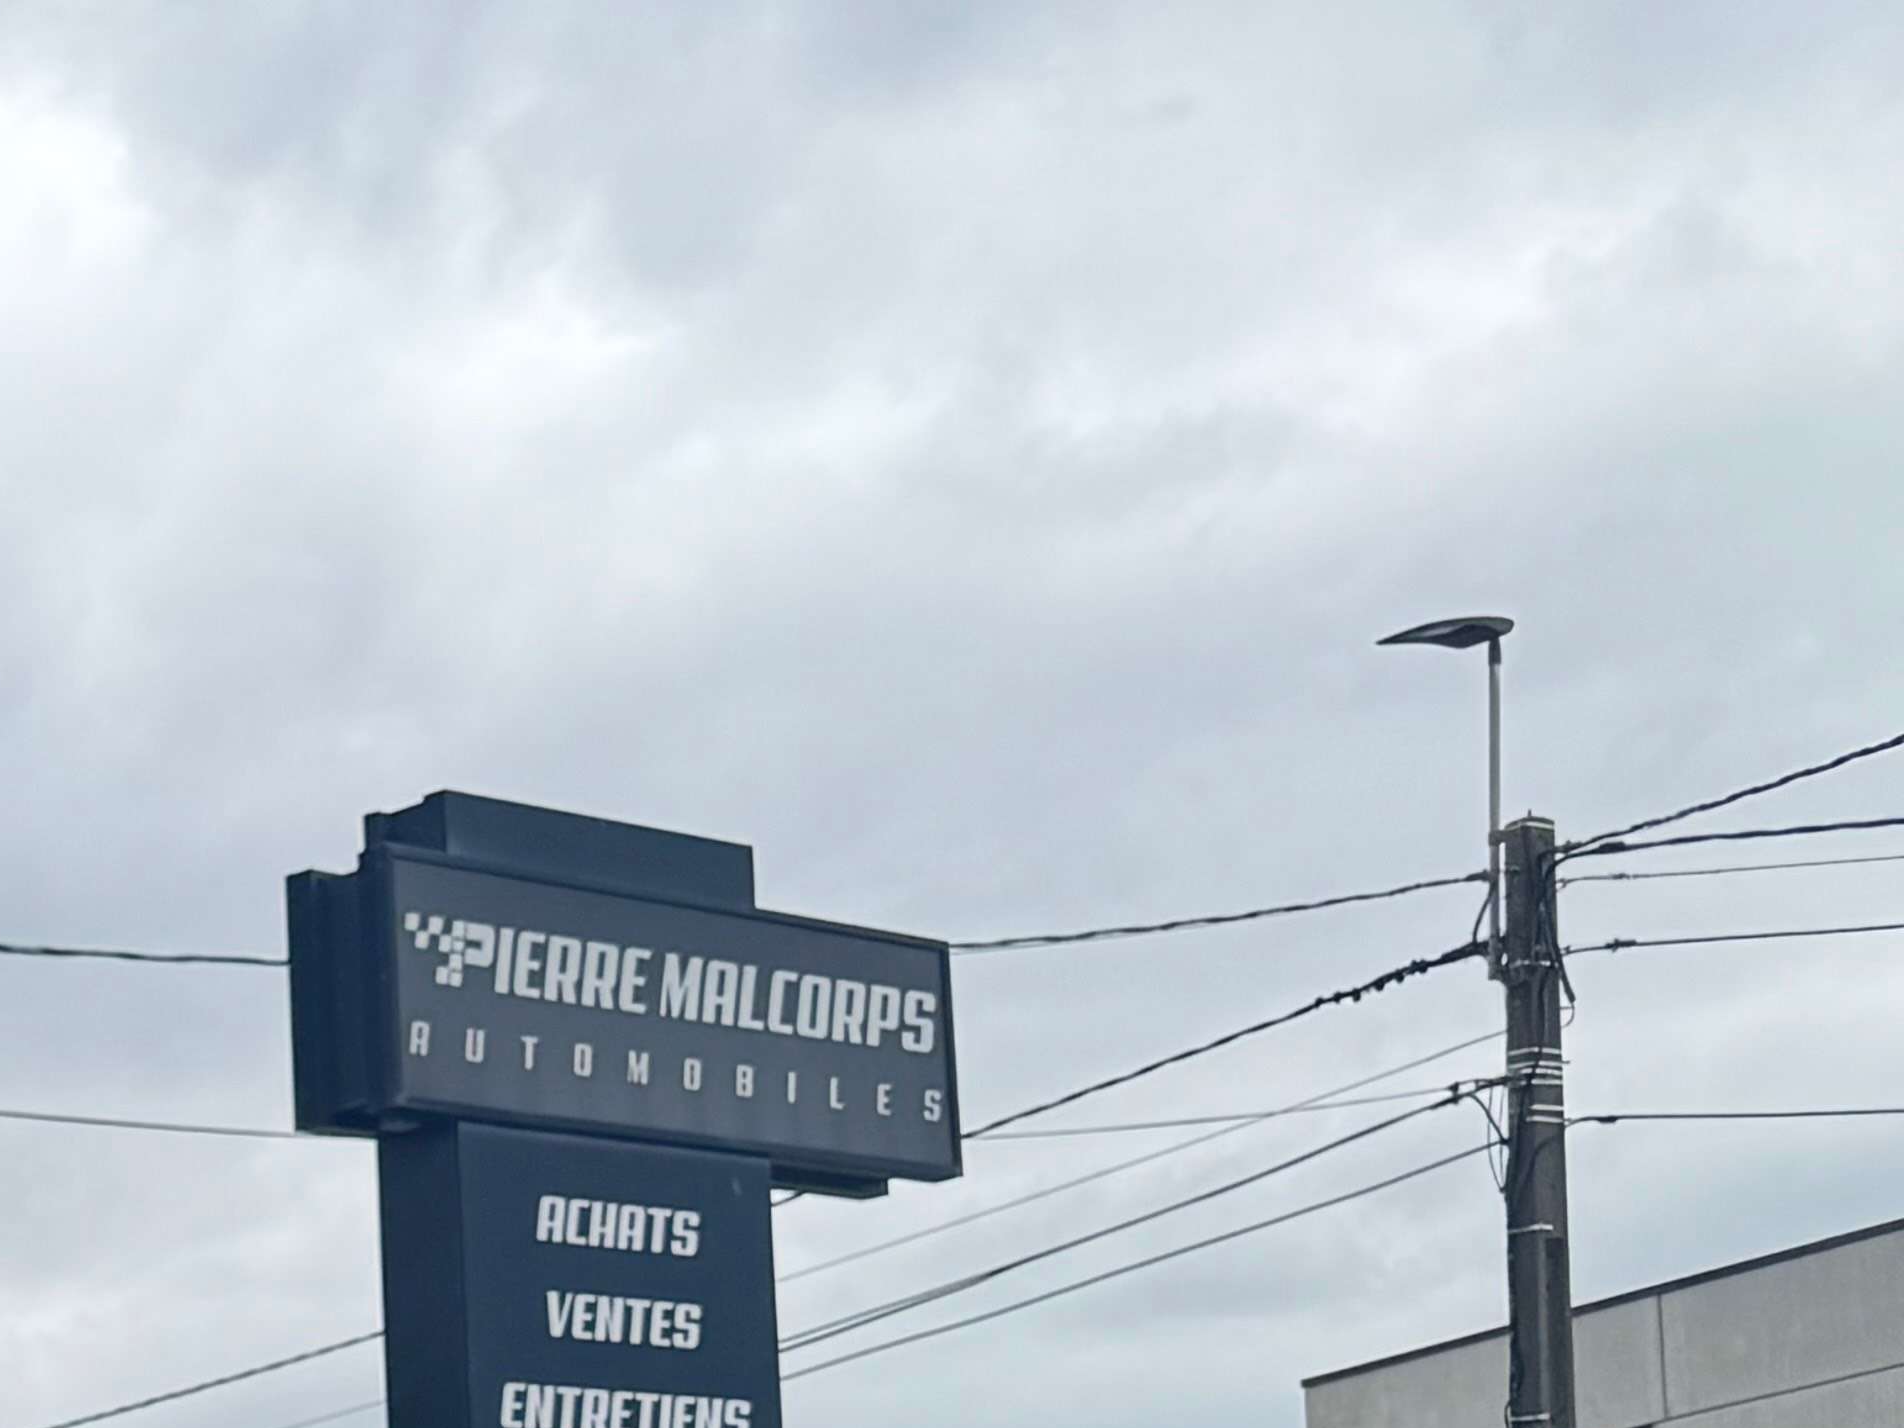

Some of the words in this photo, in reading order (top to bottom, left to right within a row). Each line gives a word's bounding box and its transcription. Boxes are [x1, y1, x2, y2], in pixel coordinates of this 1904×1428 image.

[435, 919, 653, 1015] PIERRE
[659, 953, 937, 1053] MALCORPS
[409, 1020, 943, 1121] AUTOMOBILES
[536, 1194, 703, 1258] ACHATS
[546, 1289, 704, 1350] VENTES
